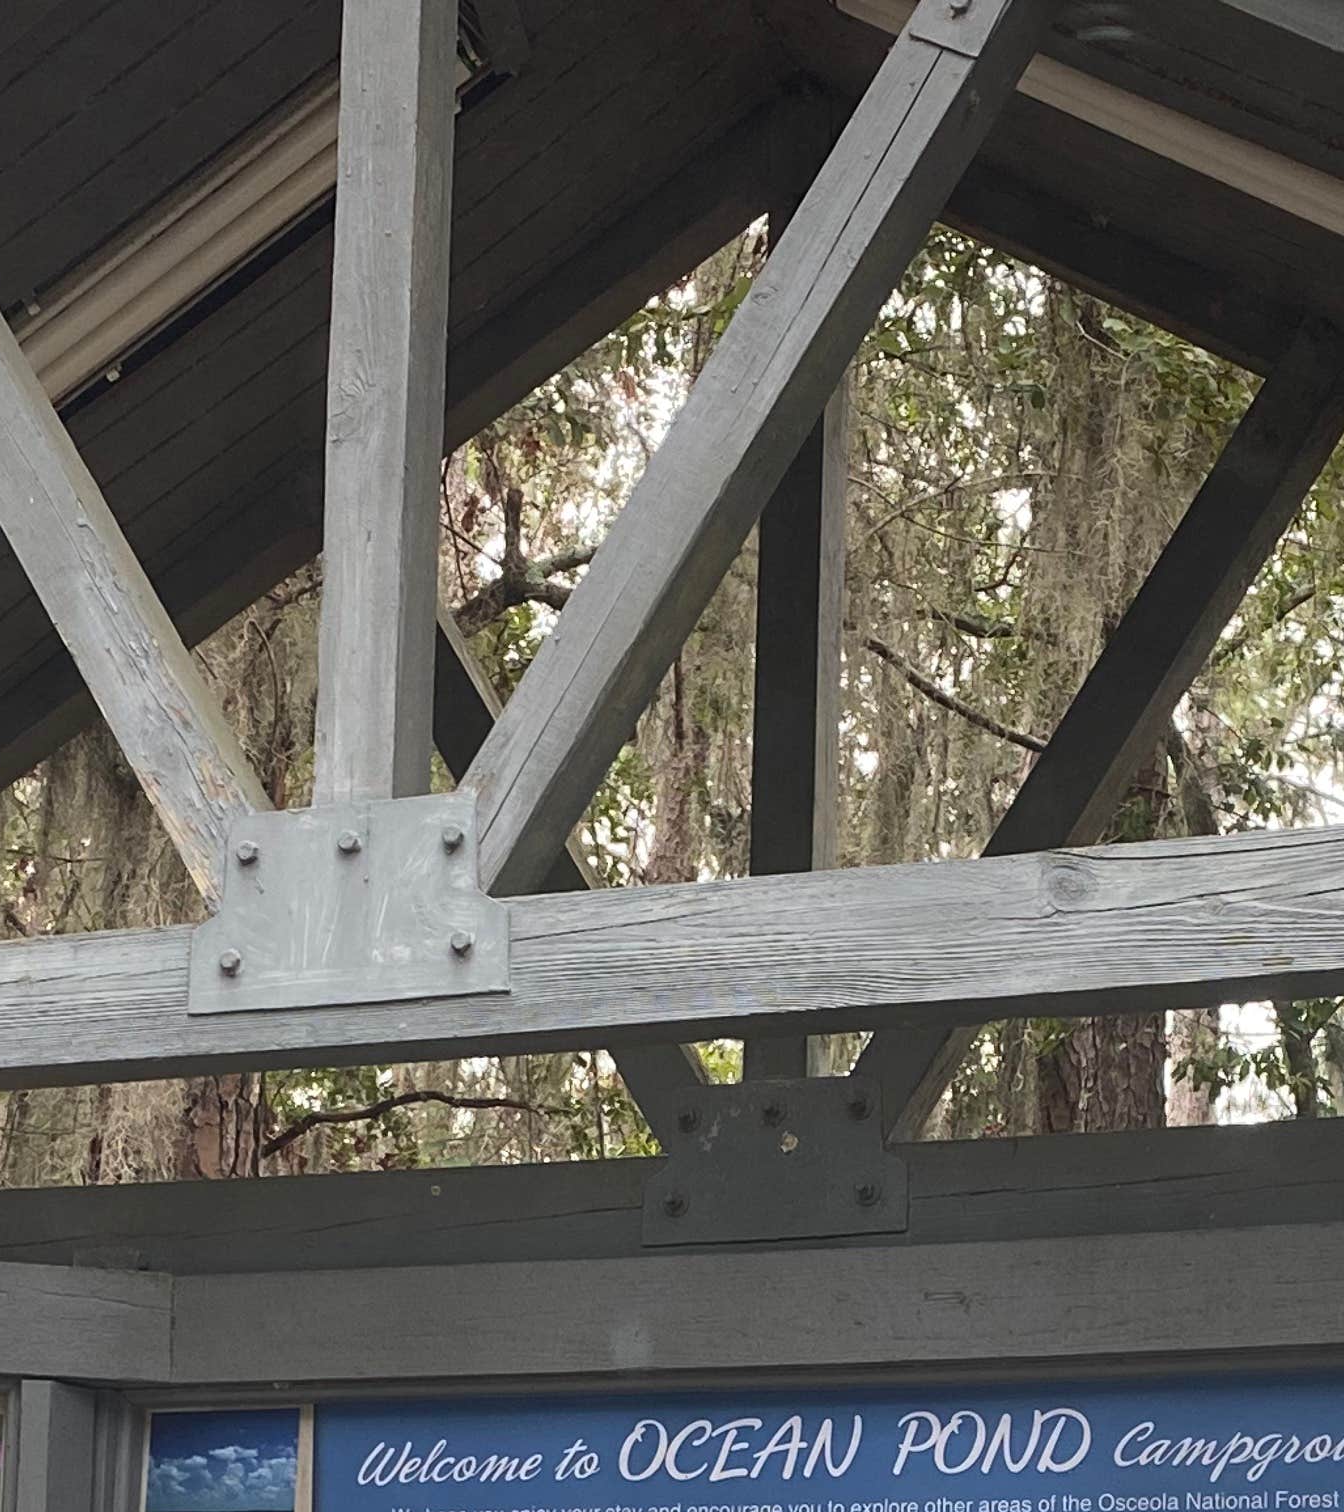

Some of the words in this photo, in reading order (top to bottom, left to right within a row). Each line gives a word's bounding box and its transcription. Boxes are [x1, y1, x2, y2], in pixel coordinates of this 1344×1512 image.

[357, 1439, 543, 1487] Welcome
[553, 1438, 601, 1481] to
[618, 1414, 863, 1482] OCEAN
[892, 1406, 1091, 1475] POND
[978, 1498, 1031, 1512] areas
[1037, 1494, 1057, 1512] of
[1061, 1494, 1091, 1512] the
[1097, 1492, 1179, 1511] Osceola
[1185, 1490, 1269, 1510] National
[1275, 1489, 1339, 1509] Forest
